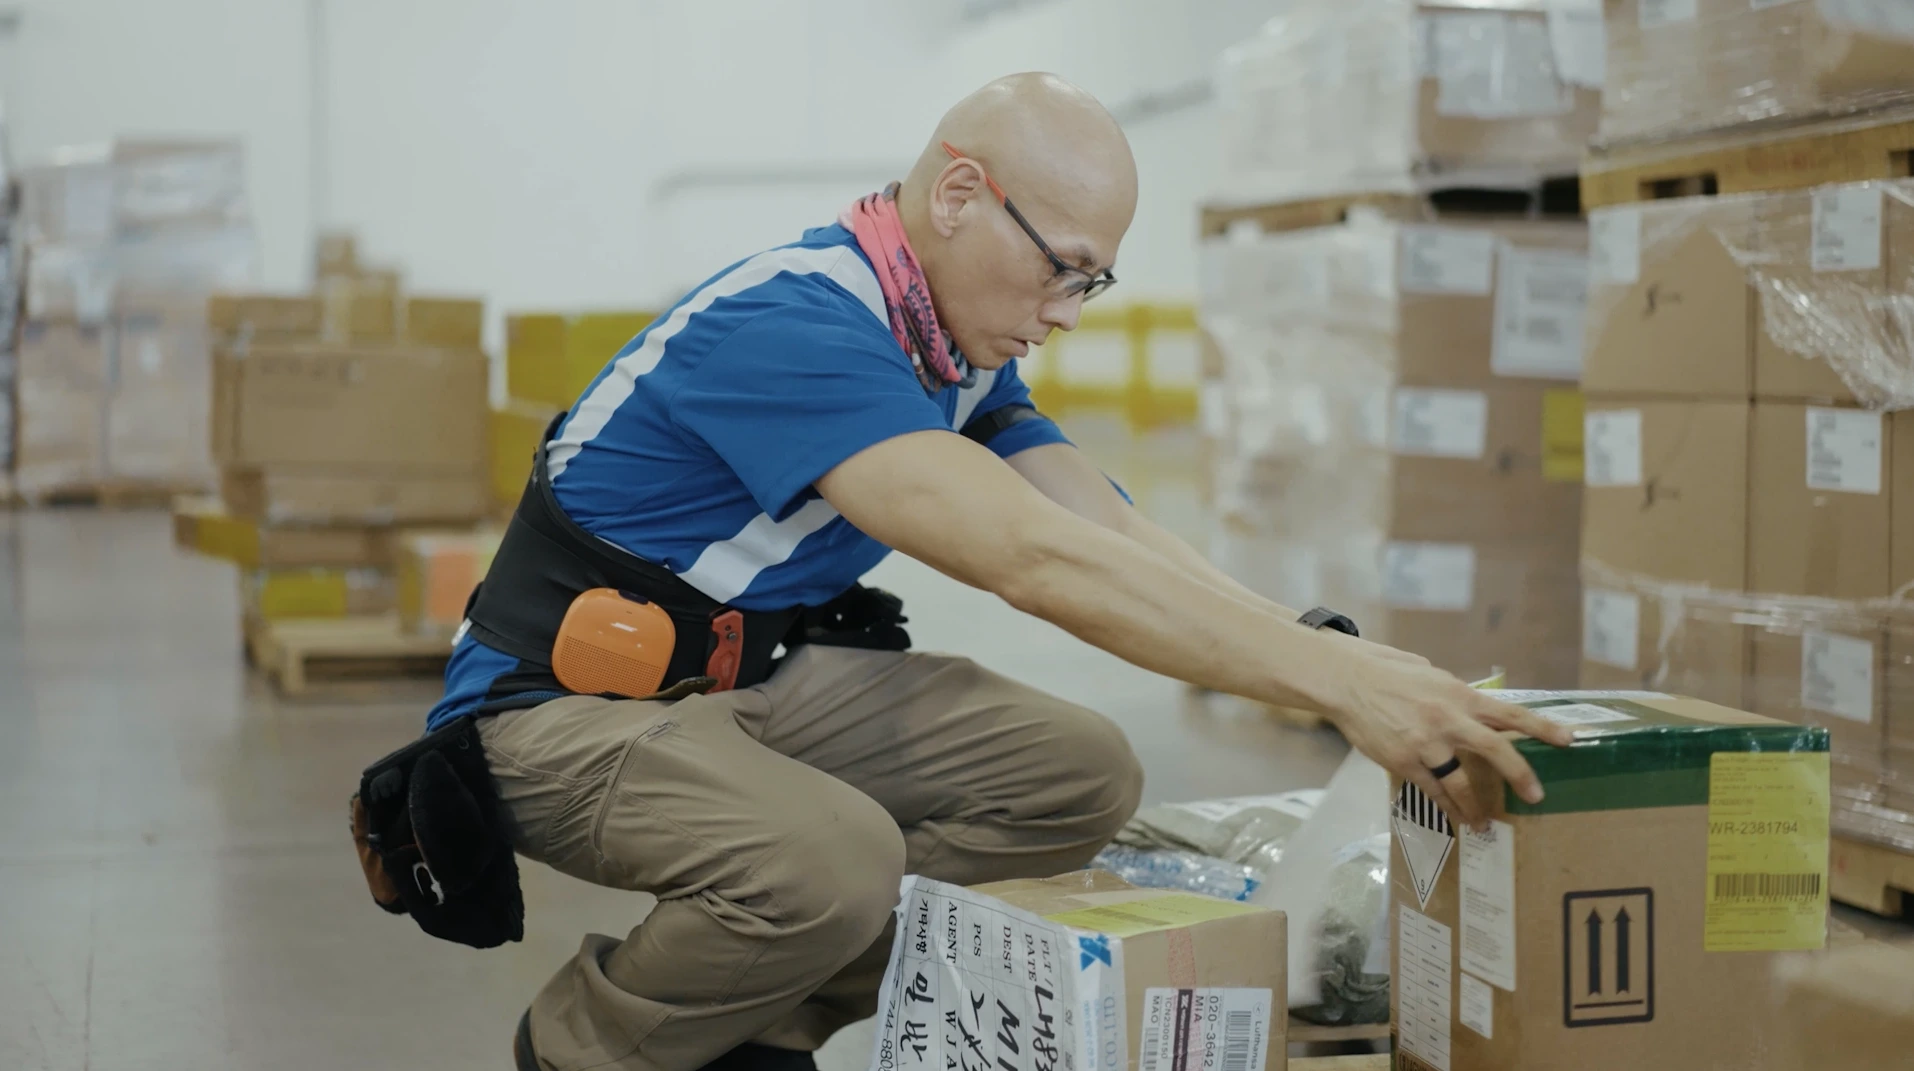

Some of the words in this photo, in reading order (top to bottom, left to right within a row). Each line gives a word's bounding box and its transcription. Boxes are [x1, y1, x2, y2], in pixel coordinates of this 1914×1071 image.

[1709, 821, 1798, 835] WR-2381794
[916, 898, 929, 955] 기타사항
[946, 901, 958, 964] AGENT
[973, 923, 982, 957] PCS
[1003, 925, 1012, 974] DEST
[1025, 932, 1037, 982] DATE
[1040, 938, 1052, 973] FLT
[1151, 995, 1160, 1024] MAO
[1194, 995, 1204, 1023] MIA
[1203, 995, 1219, 1068] 020-3642
[1250, 1020, 1262, 1070] Lufthansa
